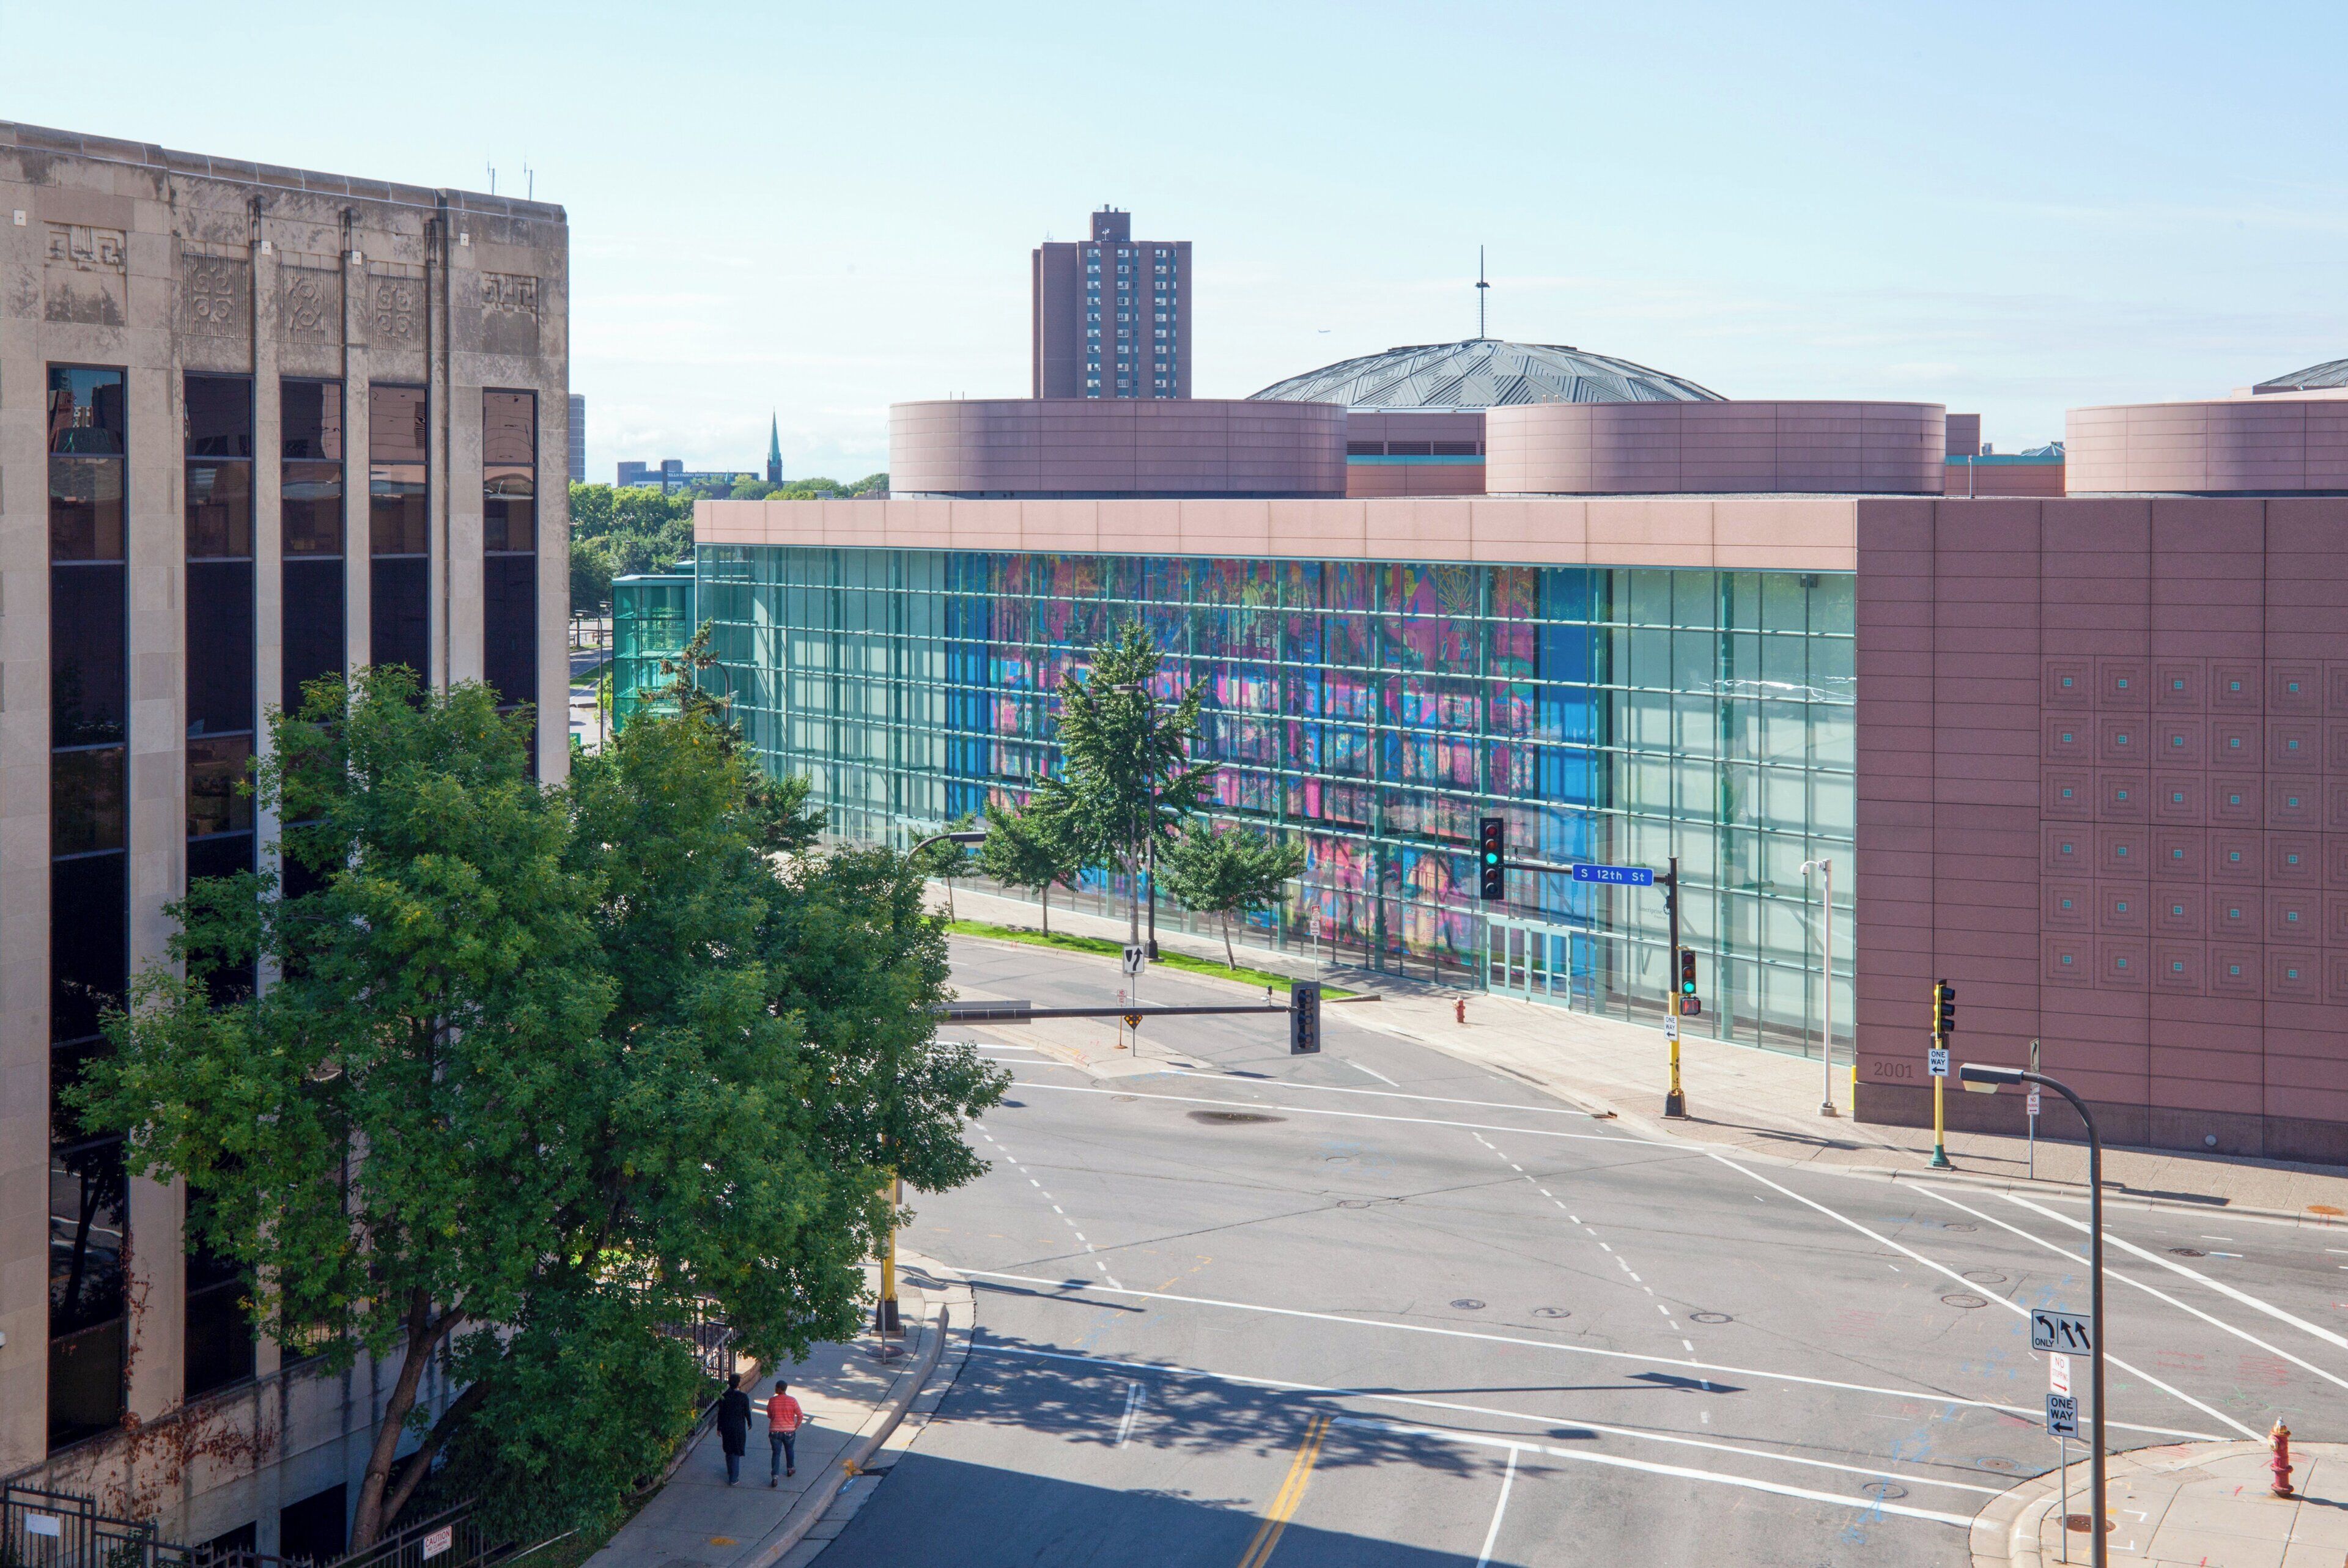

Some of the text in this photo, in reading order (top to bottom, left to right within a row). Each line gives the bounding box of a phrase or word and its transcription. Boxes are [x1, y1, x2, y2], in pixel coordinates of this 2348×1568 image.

[1581, 869, 1644, 882] S 12th St
[1639, 905, 1663, 915] Ameriprise
[1874, 1061, 1914, 1078] 2001
[2035, 1338, 2054, 1348] ONLY
[2055, 1356, 2064, 1369] NO
[2052, 1368, 2068, 1382] STOPPING
[2051, 1397, 2073, 1409] ONE
[2051, 1409, 2073, 1421] WAY
[426, 1529, 450, 1547] CAUTION
